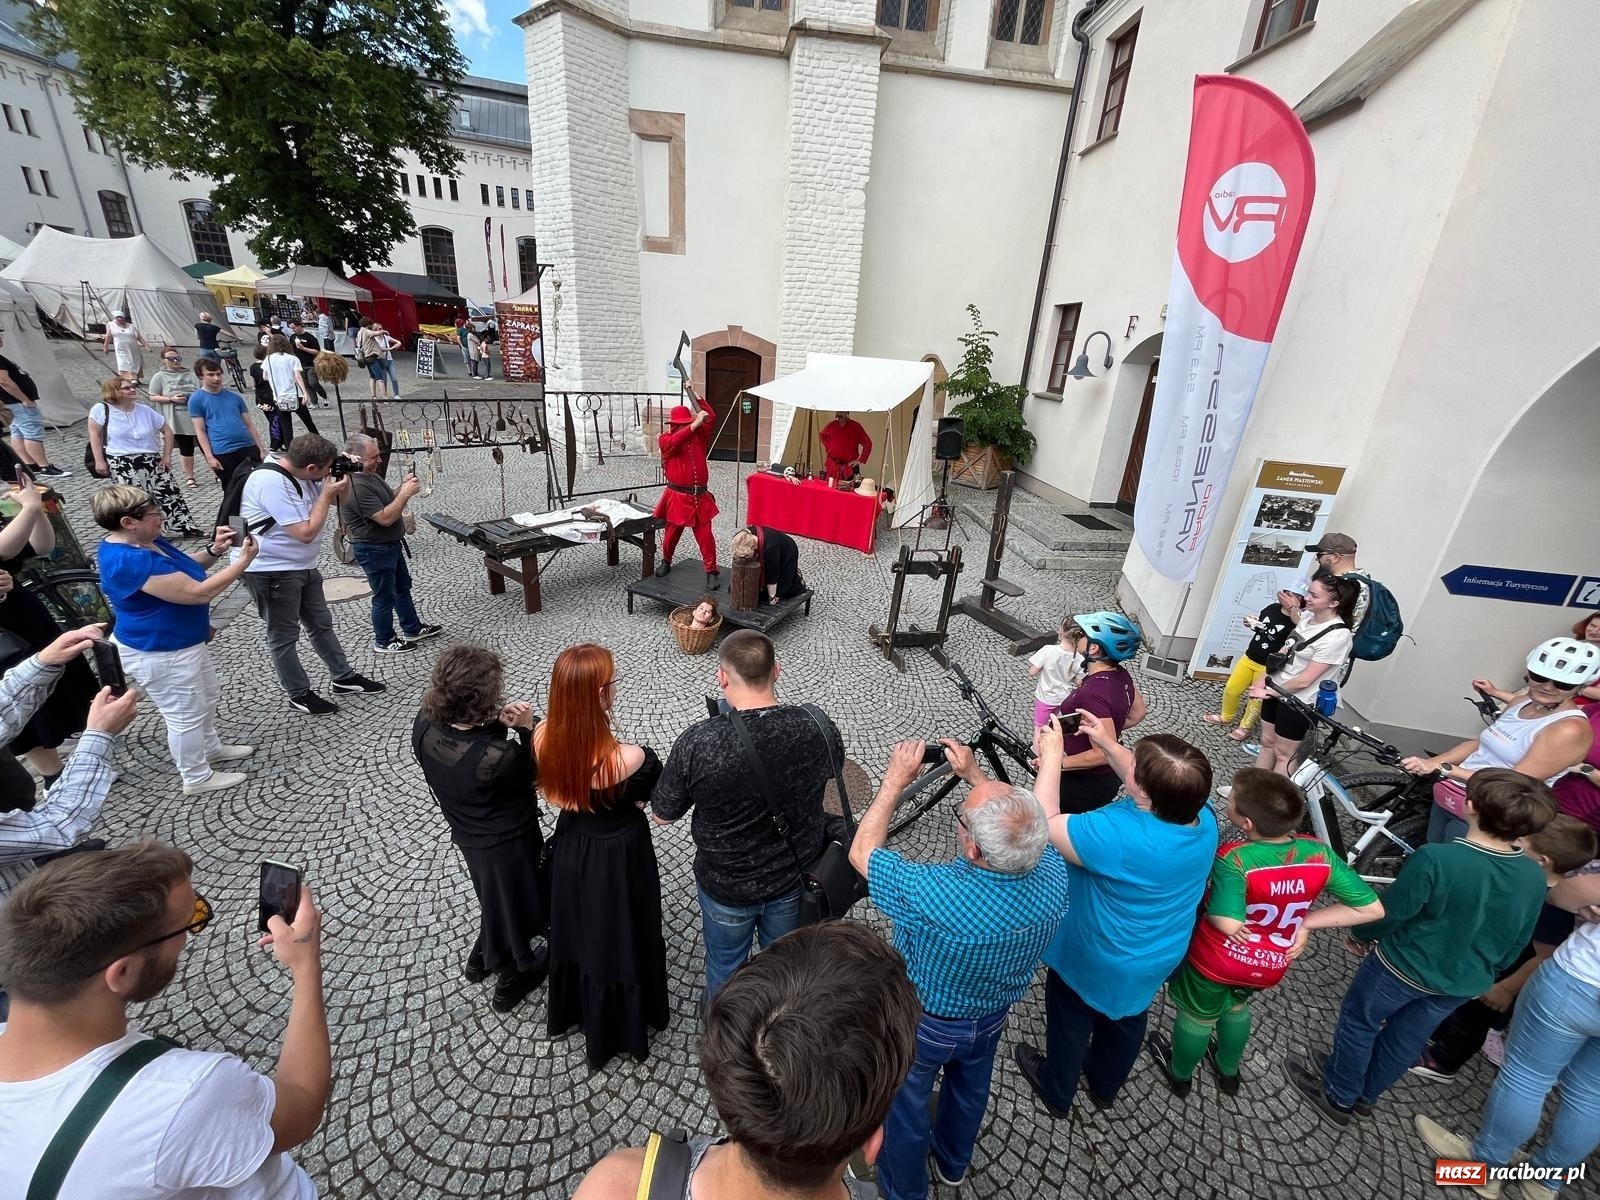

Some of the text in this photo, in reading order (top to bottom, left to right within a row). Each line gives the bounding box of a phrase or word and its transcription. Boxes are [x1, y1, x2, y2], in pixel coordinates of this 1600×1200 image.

[1463, 576, 1549, 591] Informacja Turystyczna
[1270, 879, 1306, 896] MIKA
[1244, 900, 1312, 948] 25
